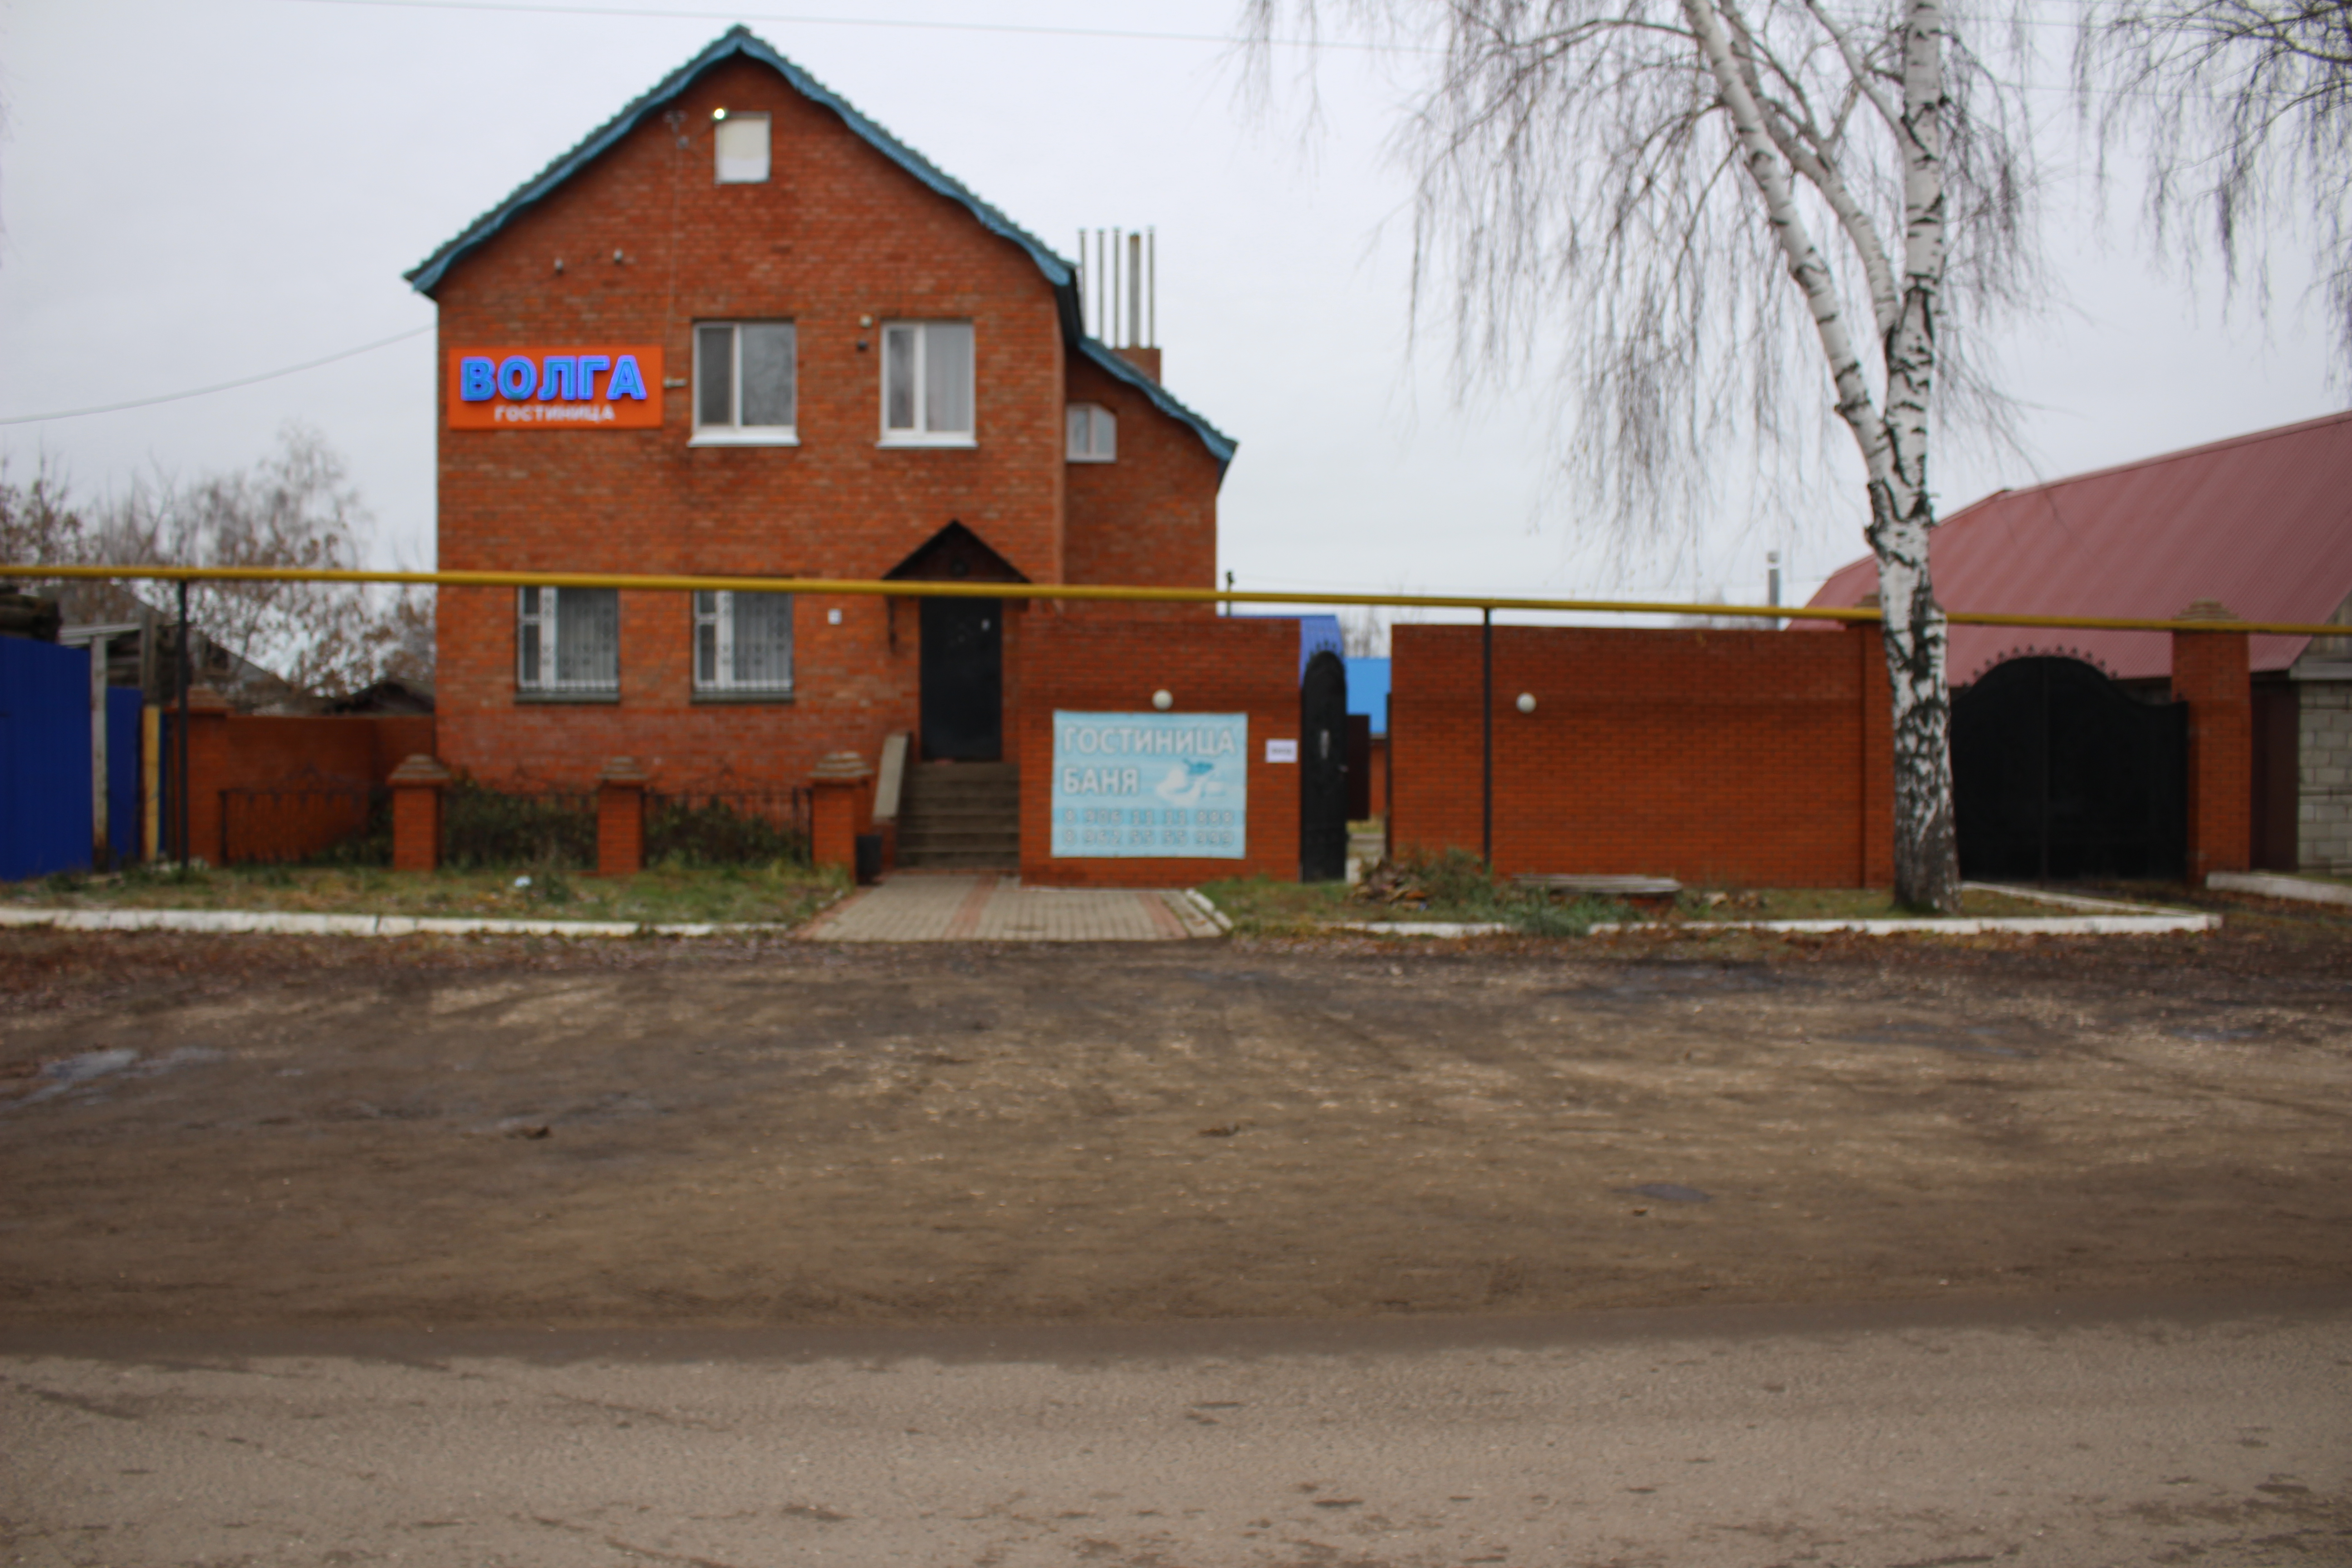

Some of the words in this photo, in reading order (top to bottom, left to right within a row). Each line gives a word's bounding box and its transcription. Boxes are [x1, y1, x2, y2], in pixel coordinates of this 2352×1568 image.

[461, 355, 647, 401] ВОЛГА
[494, 405, 615, 423] ГОСТИНИЦА
[1063, 727, 1235, 755] ГОСТИНИЦА
[1063, 768, 1139, 794] БАНЯ
[1064, 809, 1076, 826] 8
[1083, 809, 1122, 826] 906
[1132, 810, 1154, 826] 11
[1164, 810, 1187, 826] 11
[1064, 830, 1076, 846] 8
